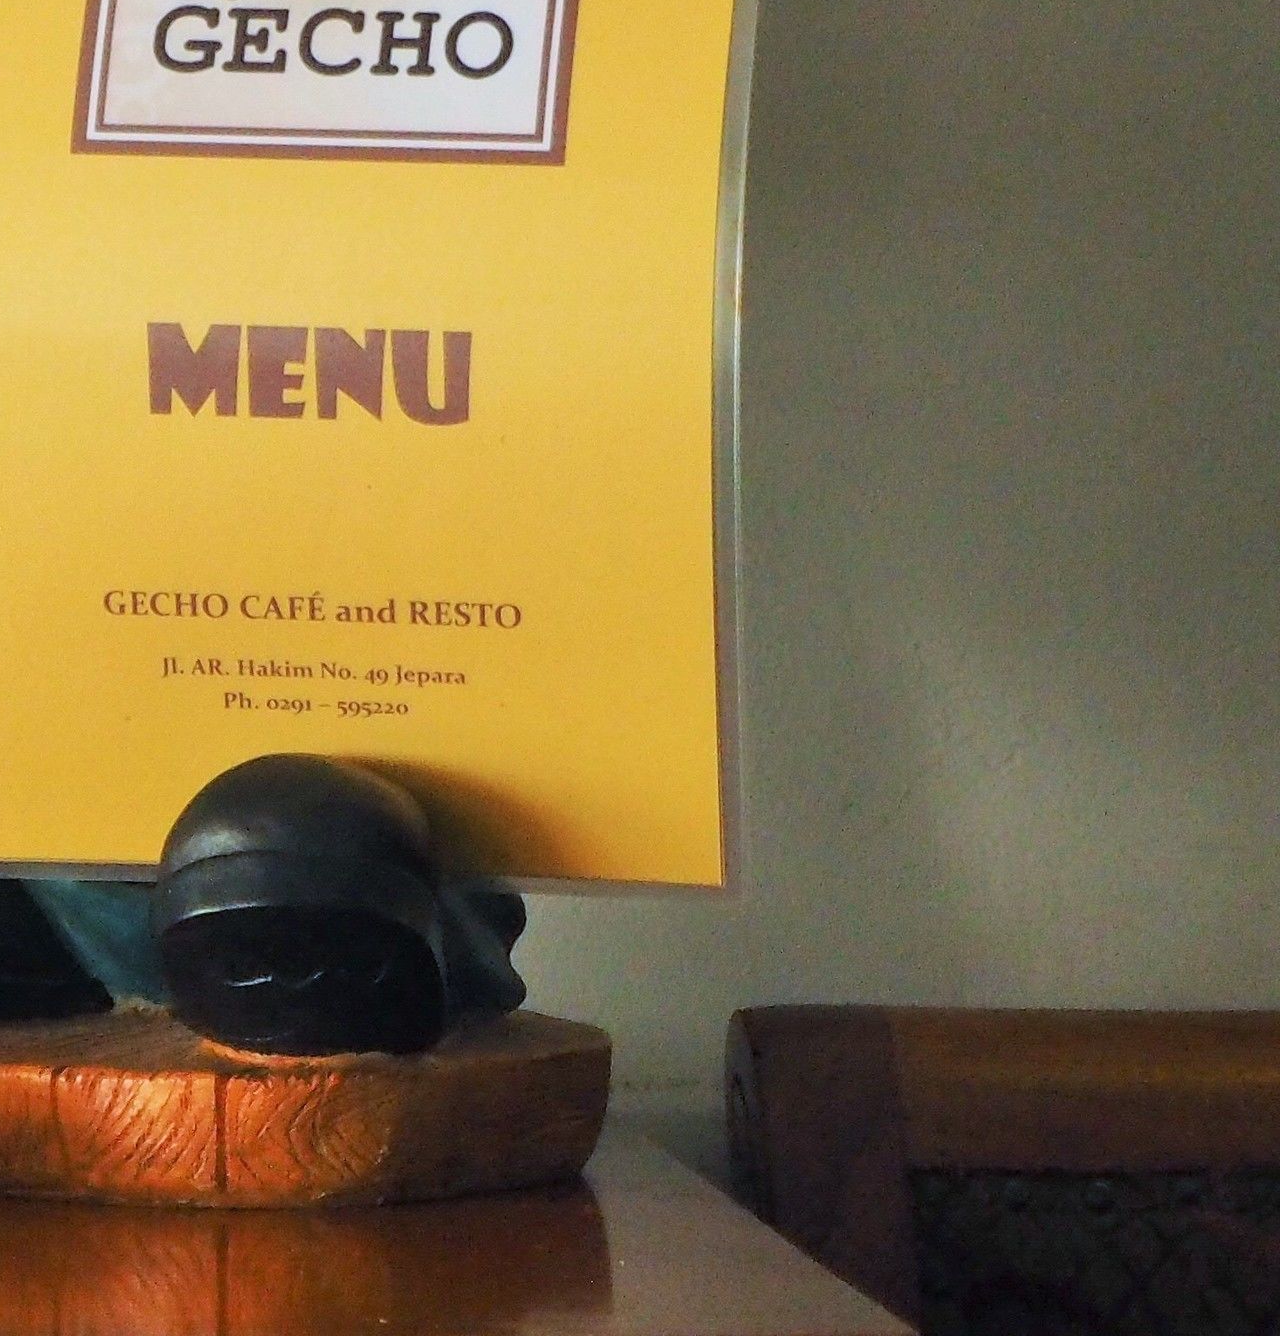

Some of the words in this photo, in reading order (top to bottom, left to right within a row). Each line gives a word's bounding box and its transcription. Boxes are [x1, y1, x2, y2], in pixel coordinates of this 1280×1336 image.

[153, 5, 515, 80] GECHO
[146, 322, 473, 426] MENU
[102, 590, 230, 620] GECHO
[239, 590, 327, 623] CAFÉ
[335, 598, 397, 625] and
[408, 600, 523, 630] RESTO
[191, 657, 230, 677] AR.
[238, 659, 314, 680] Hakim
[320, 662, 358, 681] No.
[364, 667, 390, 686] 49
[395, 665, 467, 689] Jepara
[223, 691, 259, 711] Ph.
[266, 698, 312, 715] 0291
[336, 700, 410, 717] 595220
